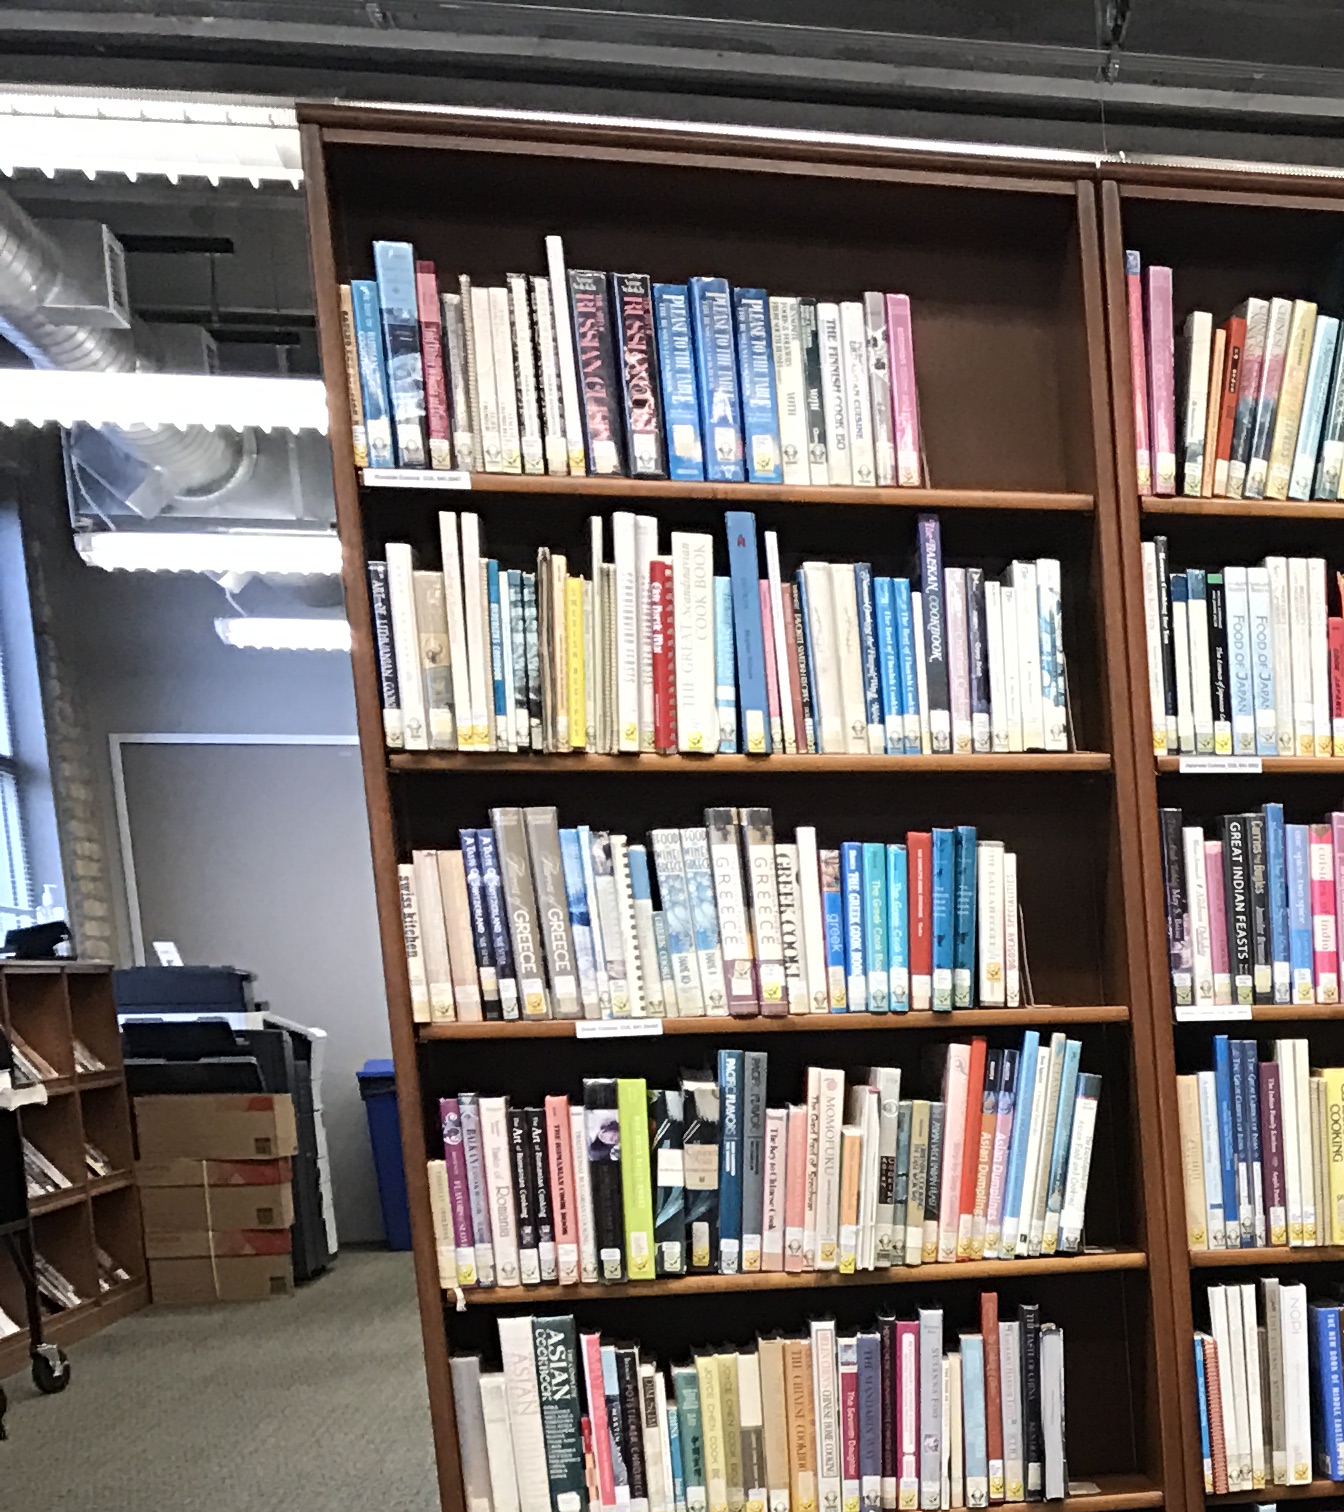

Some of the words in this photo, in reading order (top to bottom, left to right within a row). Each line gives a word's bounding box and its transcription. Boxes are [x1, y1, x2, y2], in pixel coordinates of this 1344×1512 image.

[694, 543, 707, 588] BOOK
[926, 541, 939, 593] BALKAN
[697, 592, 710, 641] COOK
[928, 596, 942, 663] COOKBOOK
[1233, 615, 1246, 650] FOOD
[1255, 615, 1268, 651] FOOD
[1235, 653, 1246, 670] OF
[1258, 653, 1268, 671] OF
[1236, 671, 1249, 714] JAPAN
[1230, 822, 1242, 862] GREAT
[399, 875, 412, 909] swiss
[1233, 866, 1246, 912] INDIAN
[403, 913, 418, 959] kitchen
[514, 908, 538, 973] GREECE
[548, 906, 570, 971] GREECE
[826, 913, 843, 953] greek
[1236, 915, 1249, 959] FEASTS
[824, 1095, 836, 1177] MOMOFUKU
[980, 1132, 990, 1162] Asian
[995, 1132, 1007, 1163] Asian
[1330, 1103, 1343, 1162] COOKING
[988, 1166, 1003, 1221] Dumplings
[1290, 1297, 1301, 1335] NOPI
[535, 1328, 554, 1401] COOKBOOK
[546, 1328, 570, 1401] ASIAN
